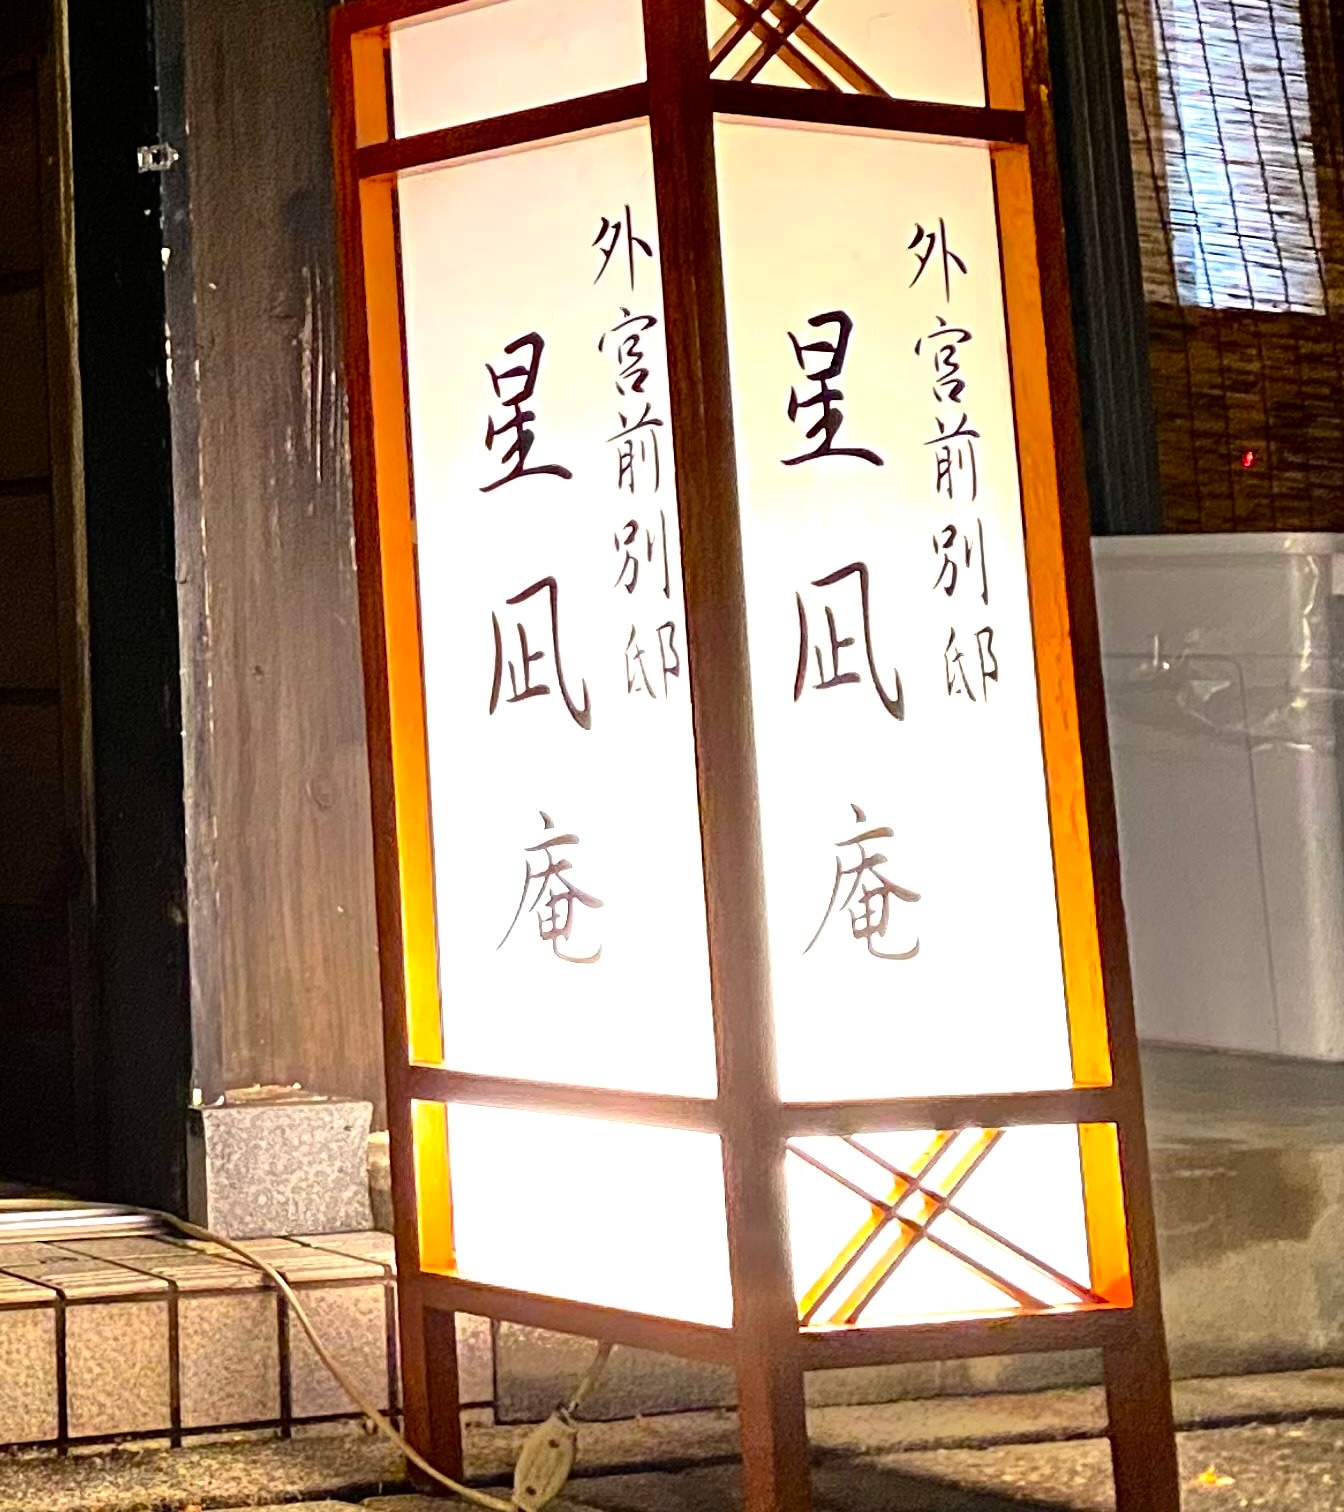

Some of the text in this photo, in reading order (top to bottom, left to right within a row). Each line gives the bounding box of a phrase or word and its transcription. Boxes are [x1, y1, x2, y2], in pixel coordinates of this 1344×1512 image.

[591, 203, 682, 700] 外宮前別邸
[906, 216, 999, 703] 外宮前別邸
